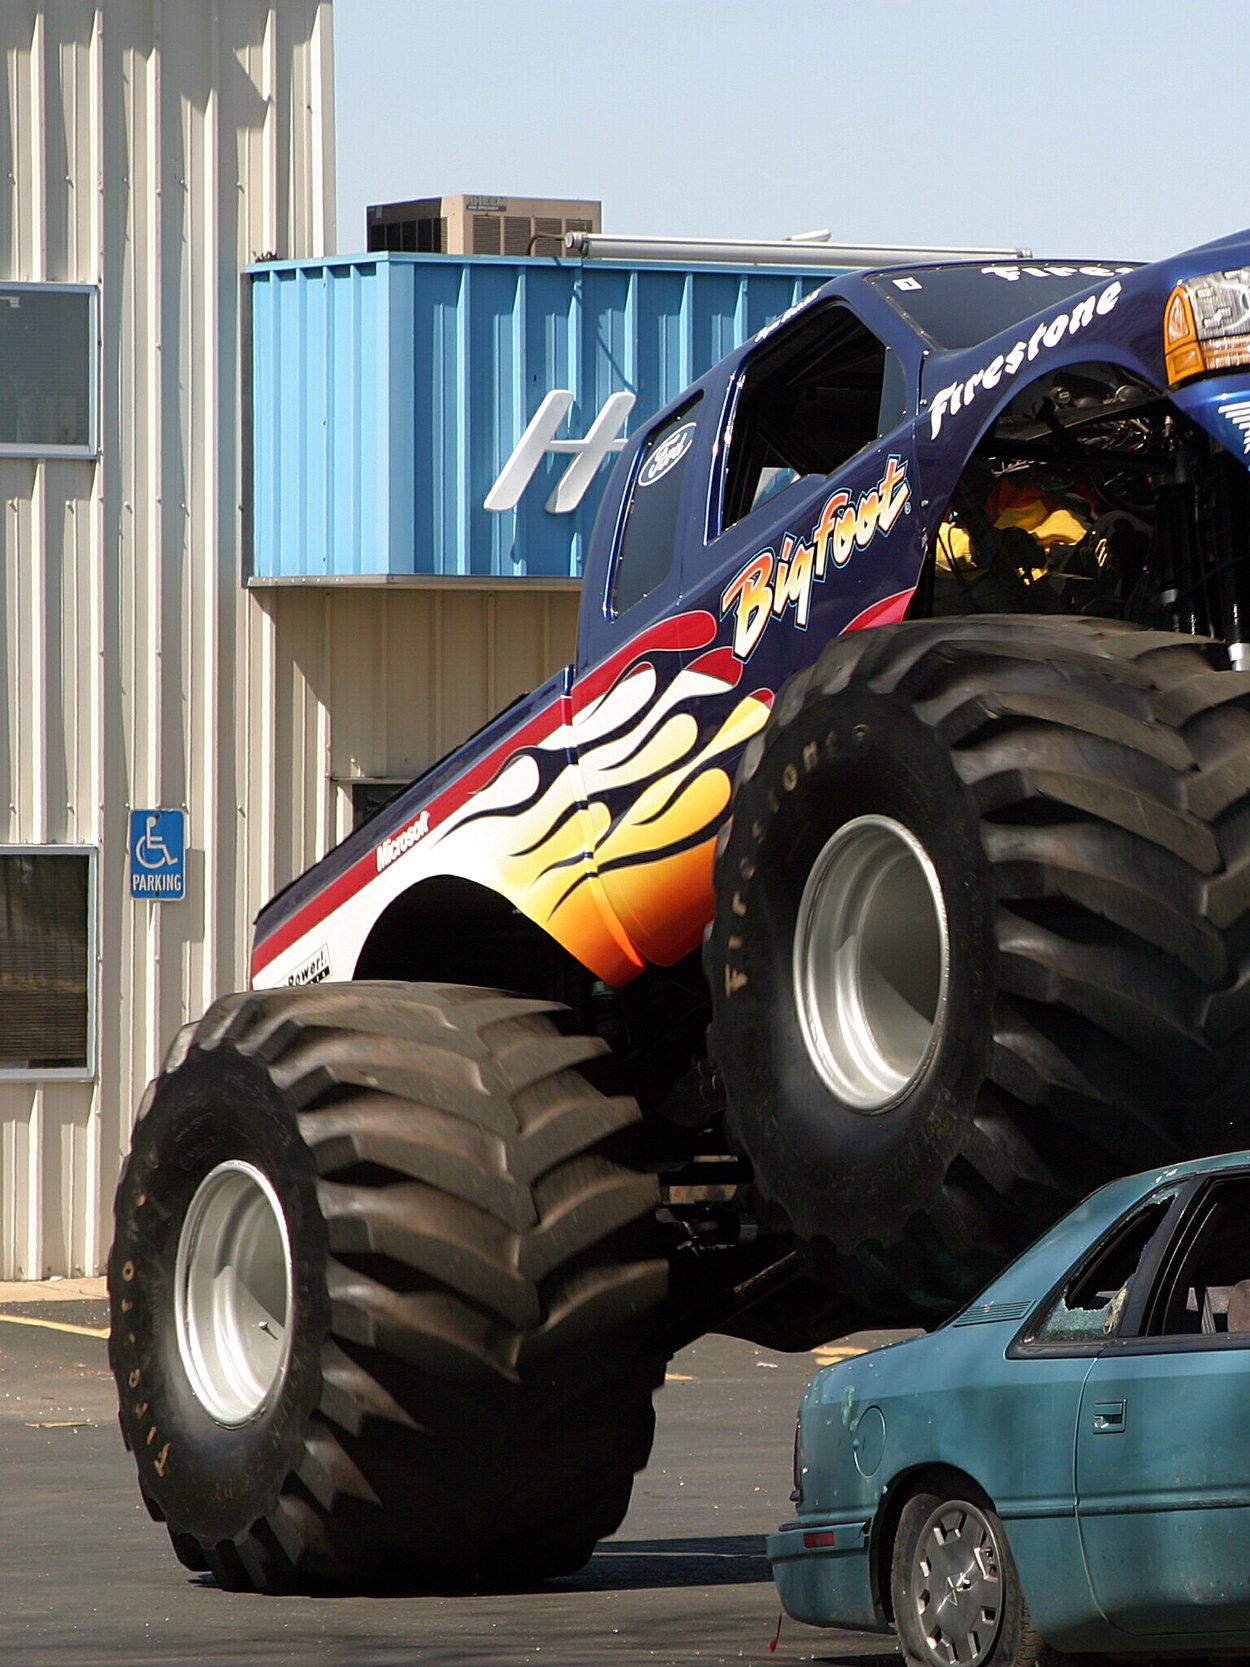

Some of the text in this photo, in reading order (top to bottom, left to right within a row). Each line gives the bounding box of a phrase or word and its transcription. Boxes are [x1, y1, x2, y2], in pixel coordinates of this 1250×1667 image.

[928, 281, 1122, 440] Firestone
[645, 430, 690, 480] Ford
[721, 456, 911, 661] Bigfoot
[376, 811, 430, 872] Microsoft
[132, 874, 182, 891] PARKING
